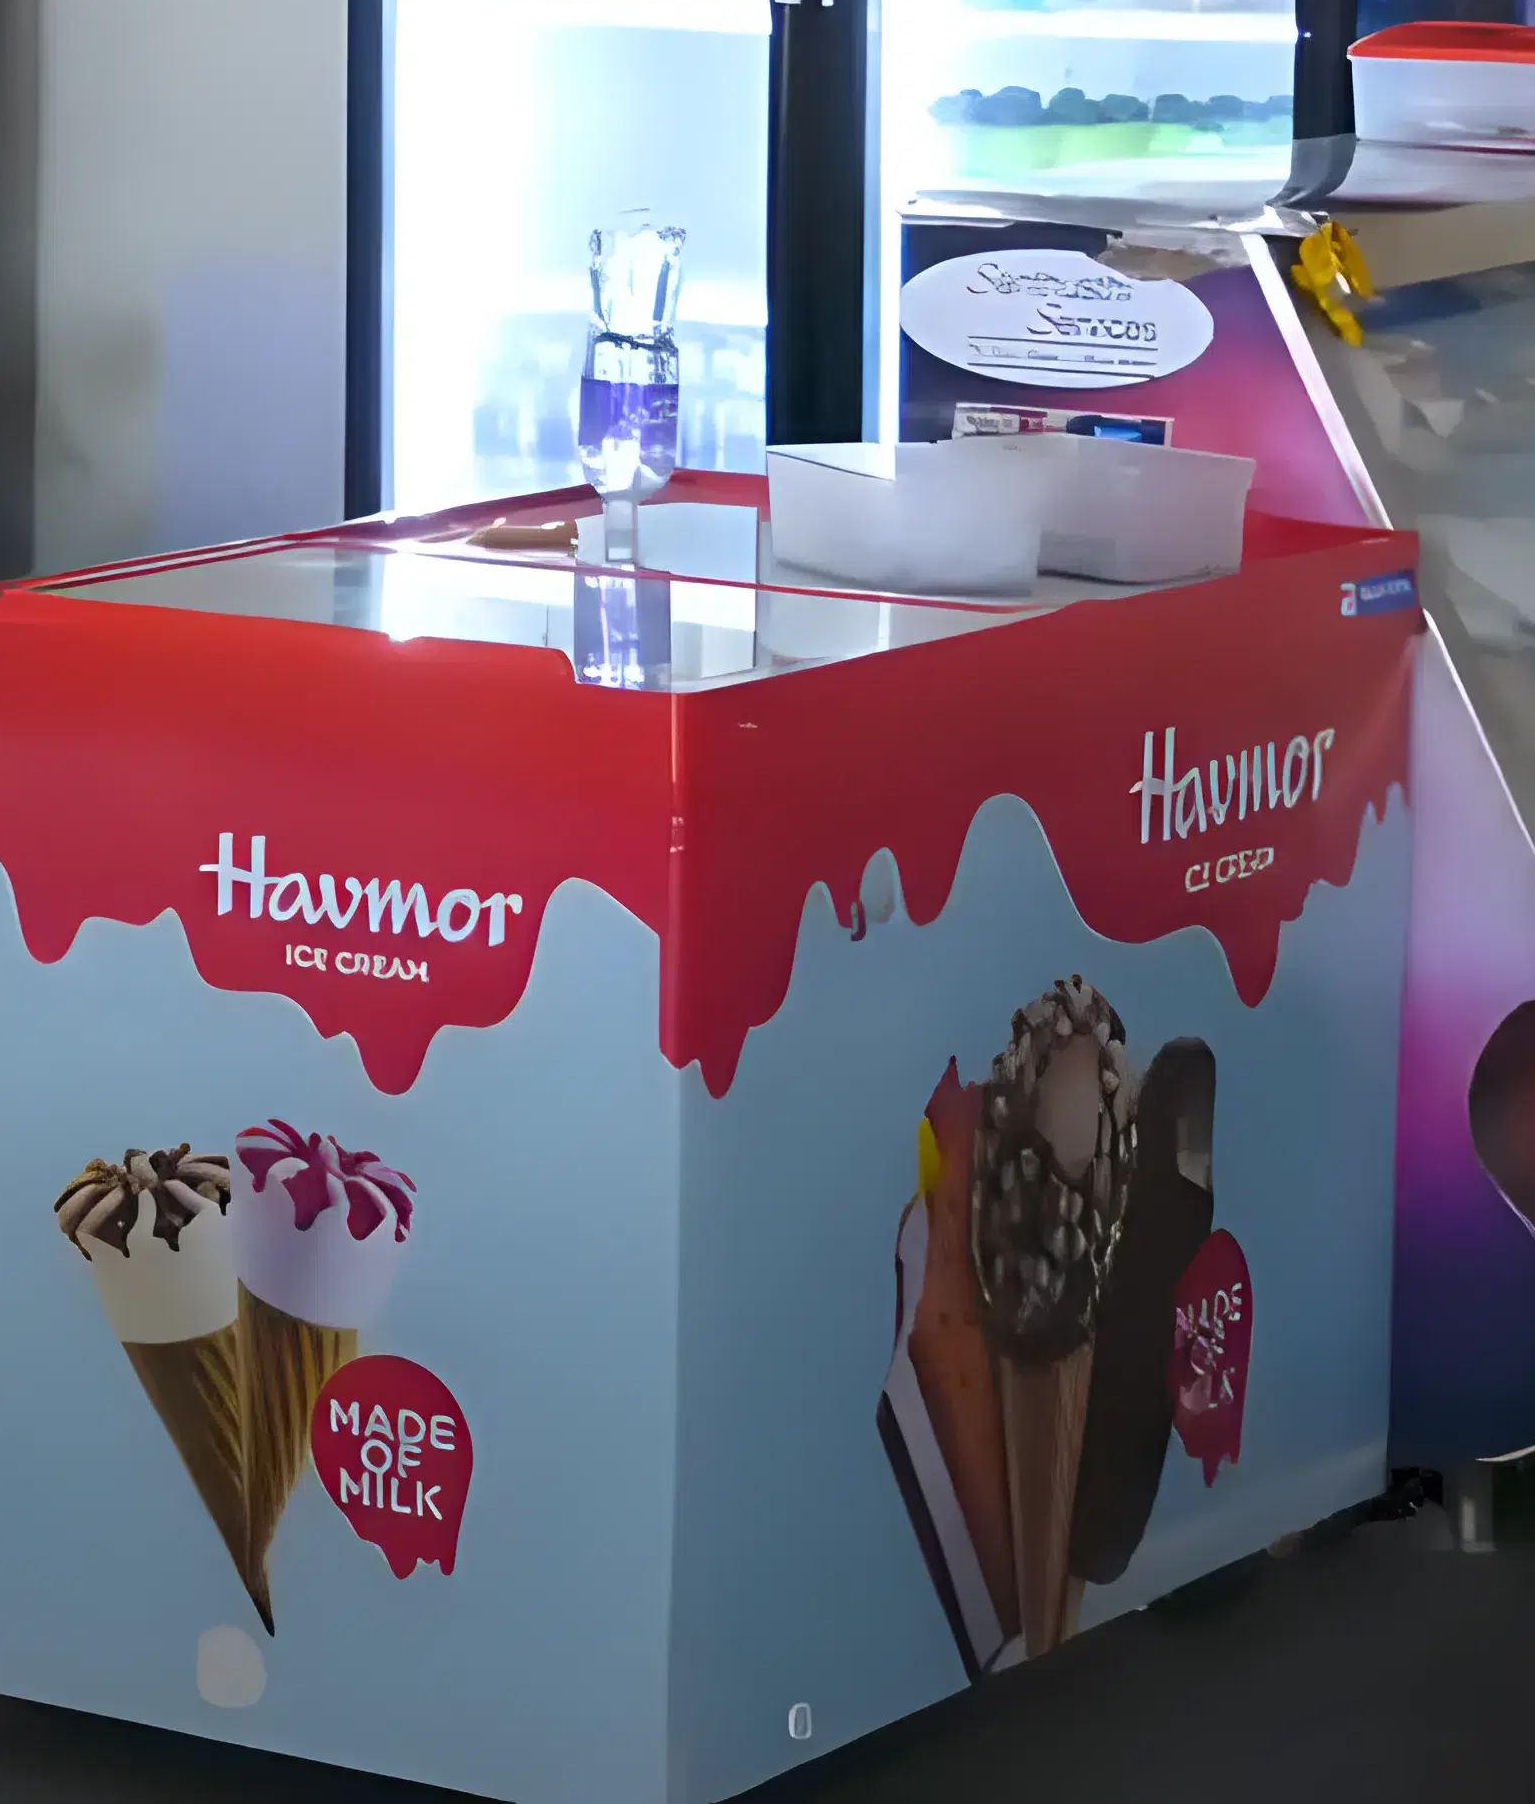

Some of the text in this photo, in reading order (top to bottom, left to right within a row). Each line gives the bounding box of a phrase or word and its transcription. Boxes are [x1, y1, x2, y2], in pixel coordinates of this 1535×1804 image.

[1129, 726, 1335, 844] Havmor
[199, 832, 523, 947] Havmor
[330, 1398, 457, 1451] MADE
[360, 1439, 422, 1479] OF
[339, 1467, 443, 1521] MILK
